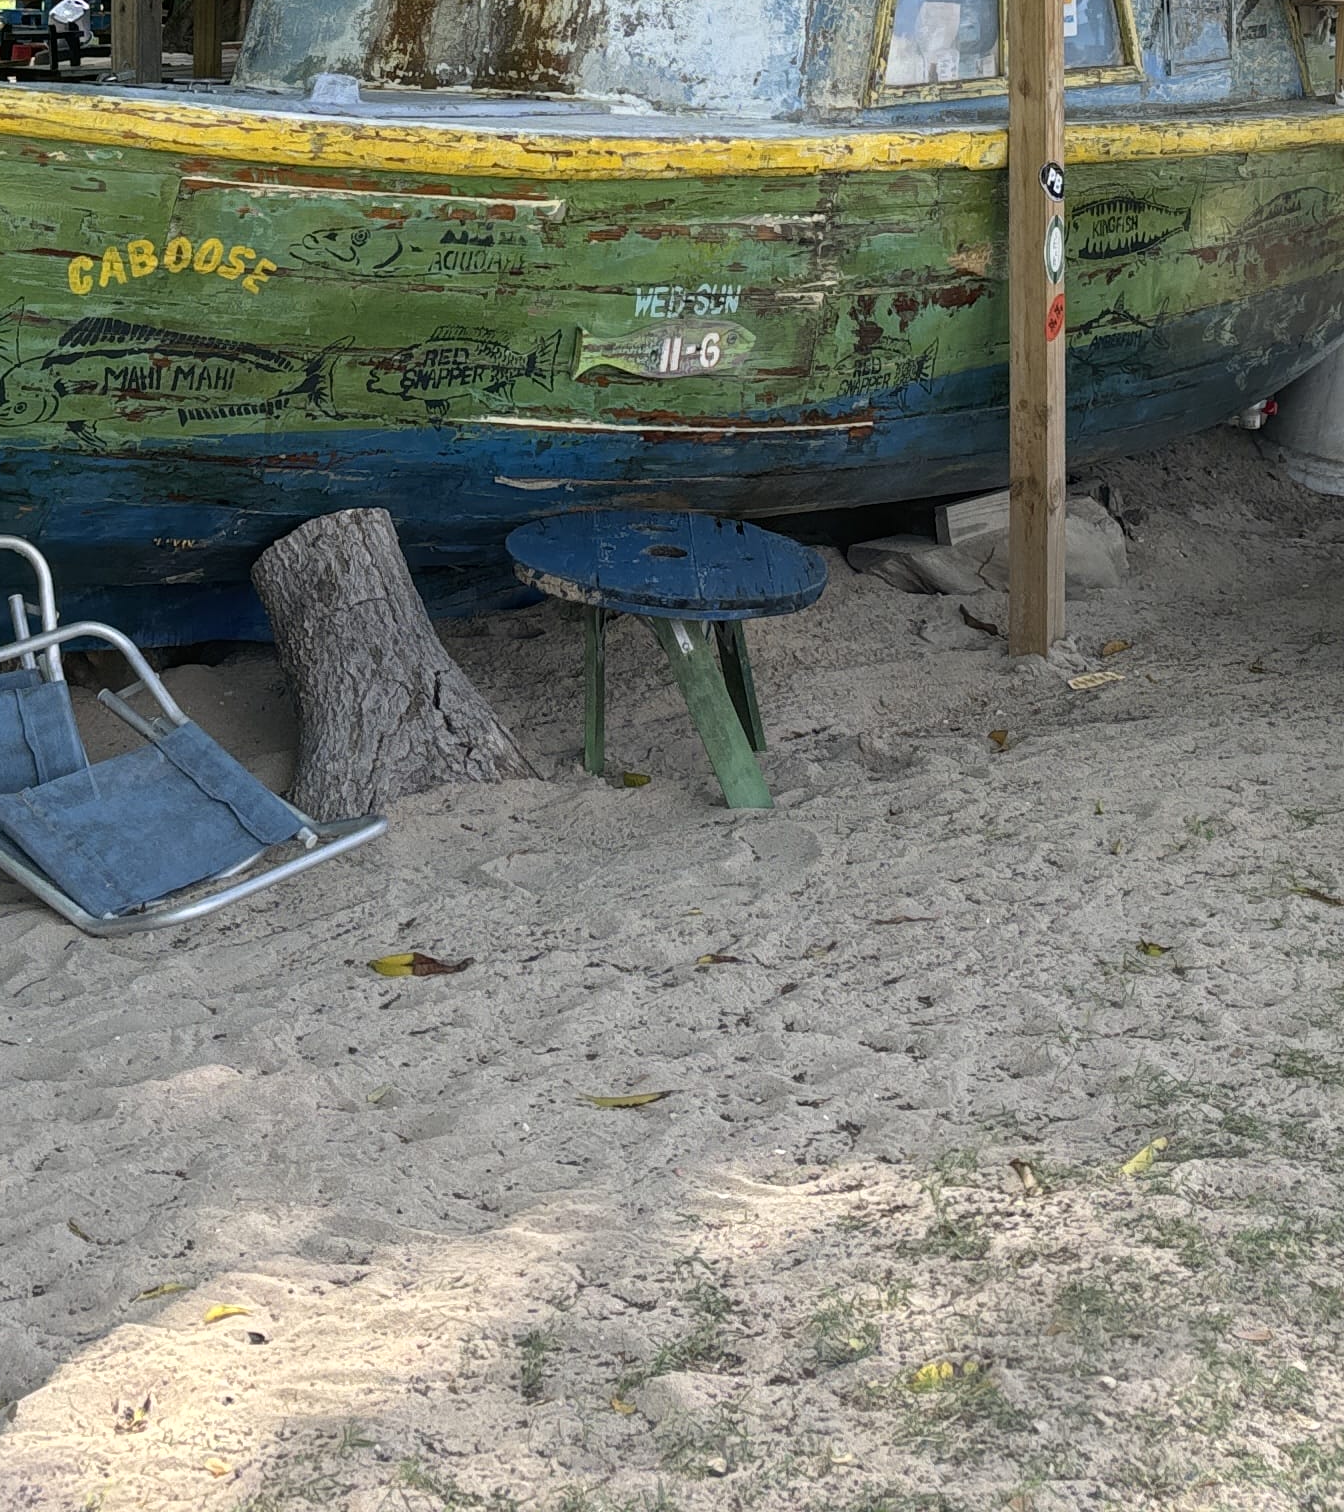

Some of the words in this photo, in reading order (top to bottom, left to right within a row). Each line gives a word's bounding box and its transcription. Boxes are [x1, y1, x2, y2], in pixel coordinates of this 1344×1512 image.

[1092, 215, 1139, 238] KINGFISH
[68, 237, 277, 295] CABOOSE
[635, 283, 741, 318] WED-SUN
[423, 348, 470, 368] RED
[660, 332, 720, 372] 11-6
[400, 368, 485, 390] SNAPPER
[853, 356, 881, 377] RED
[102, 365, 162, 395] MAHI
[171, 365, 235, 392] MAHI
